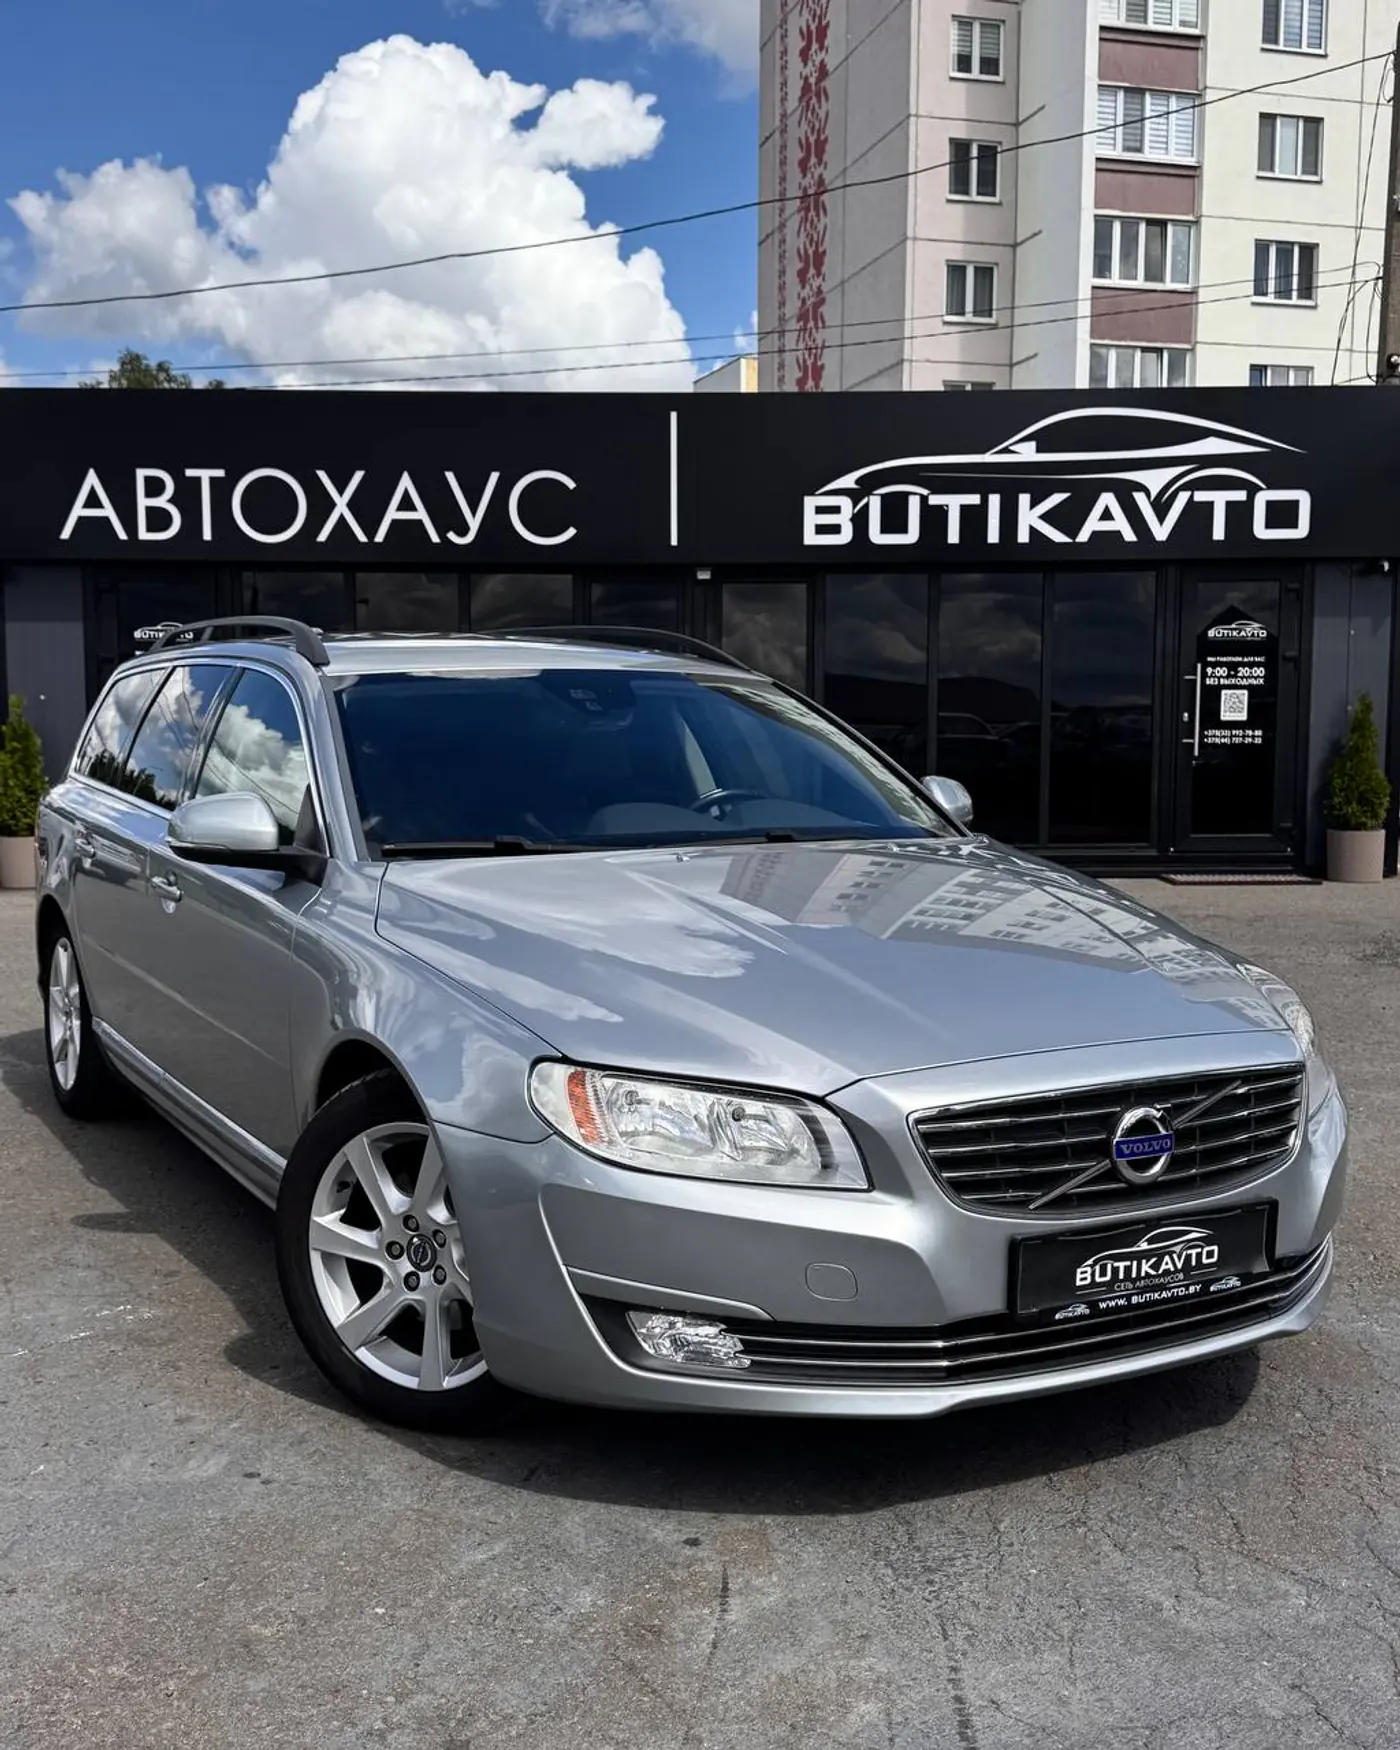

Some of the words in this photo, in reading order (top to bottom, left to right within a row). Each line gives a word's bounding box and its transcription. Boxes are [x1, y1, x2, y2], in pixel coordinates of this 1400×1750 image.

[59, 467, 577, 546] АВТОХАУС
[803, 489, 1311, 546] BUTIKAVTO
[1207, 629, 1267, 637] BUTIKAVTO
[1206, 667, 1228, 677] 9:00
[1237, 667, 1265, 677] 20:00
[1120, 1139, 1171, 1154] VOLVO
[1075, 1245, 1219, 1287] BUTIKAVTO
[1114, 1281, 1134, 1292] СЕТЬ
[1134, 1272, 1184, 1288] АВТОХАУСОВ
[1098, 1297, 1128, 1310] WWW.
[1131, 1284, 1202, 1304] BUTIKAVTO.BY
